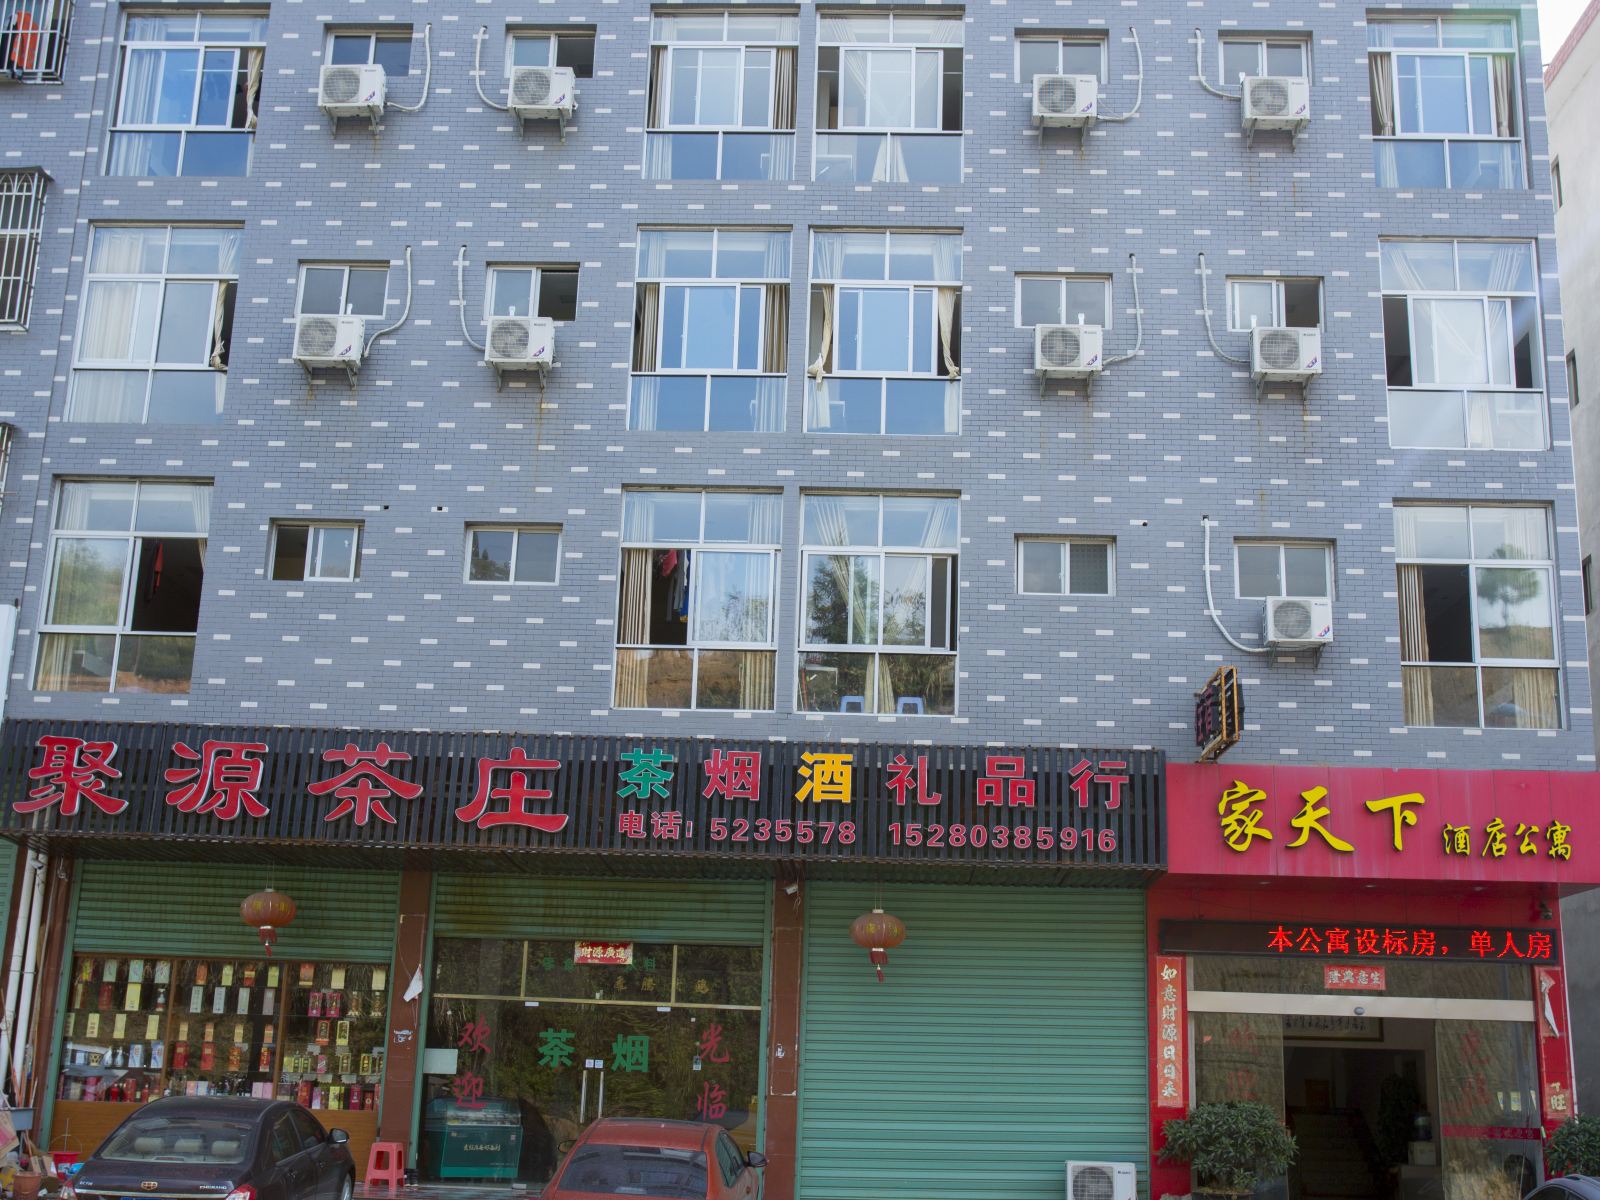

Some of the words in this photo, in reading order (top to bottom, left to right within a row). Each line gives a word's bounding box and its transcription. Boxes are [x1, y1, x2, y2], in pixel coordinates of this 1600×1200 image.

[13, 735, 570, 832] 聚源茶庄
[617, 747, 1129, 810] 茶烟酒礼品行
[710, 817, 856, 845] 5235578
[888, 822, 1116, 851] 15280385916
[1218, 780, 1426, 853] 家天下
[1442, 817, 1573, 861] 酒店公寓
[452, 1014, 491, 1110] 欢迎
[696, 1023, 731, 1121] 光临
